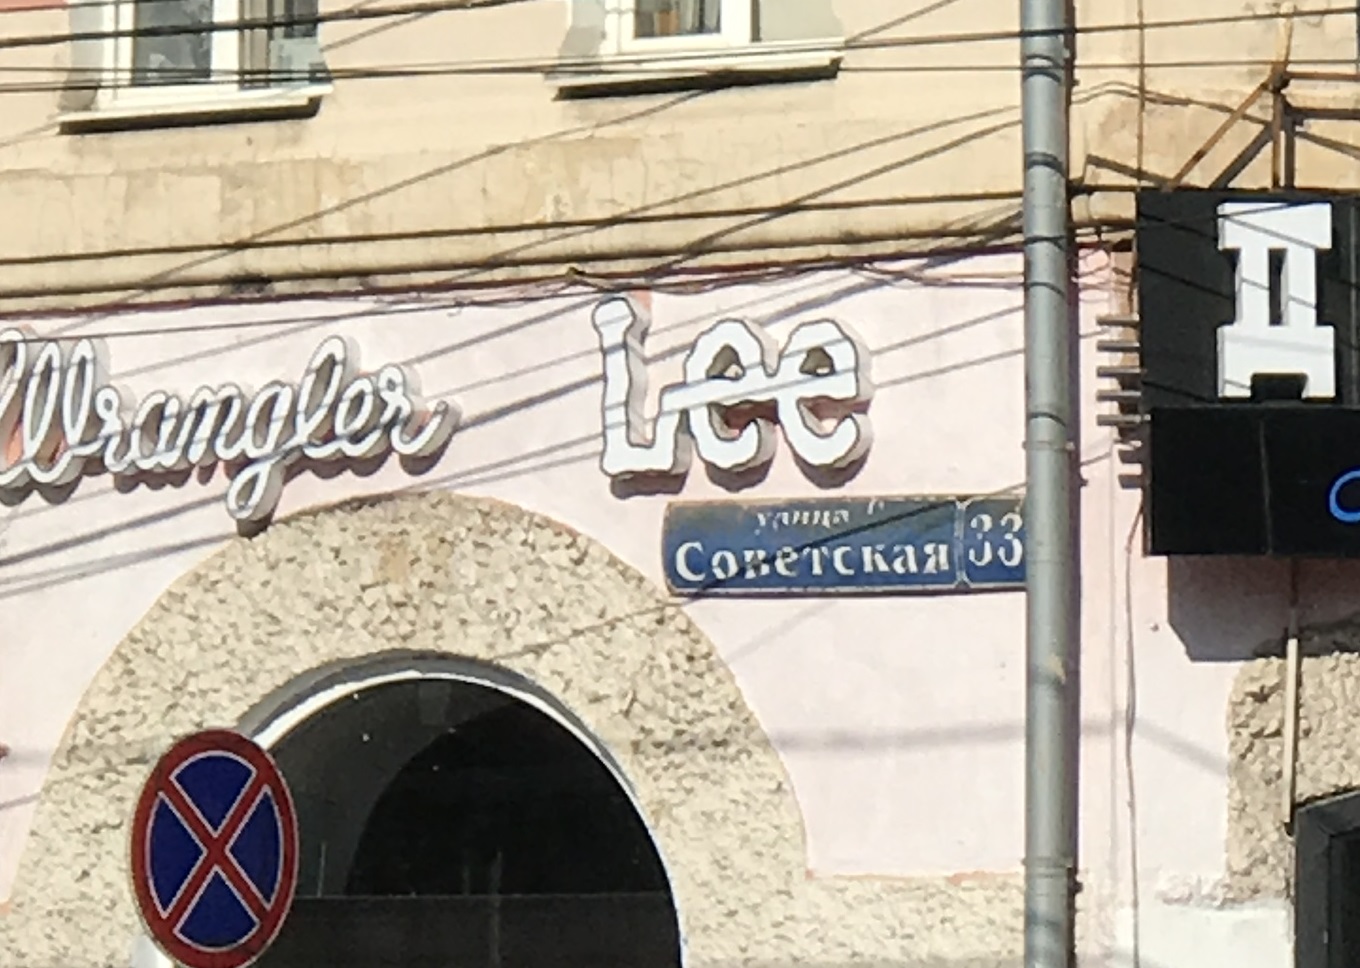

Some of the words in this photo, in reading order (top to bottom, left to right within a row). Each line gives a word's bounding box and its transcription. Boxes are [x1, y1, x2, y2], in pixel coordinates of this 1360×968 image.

[0, 327, 456, 522] Wrangler
[592, 297, 866, 482] Lee
[674, 539, 950, 581] Советская
[968, 511, 1023, 567] 33
